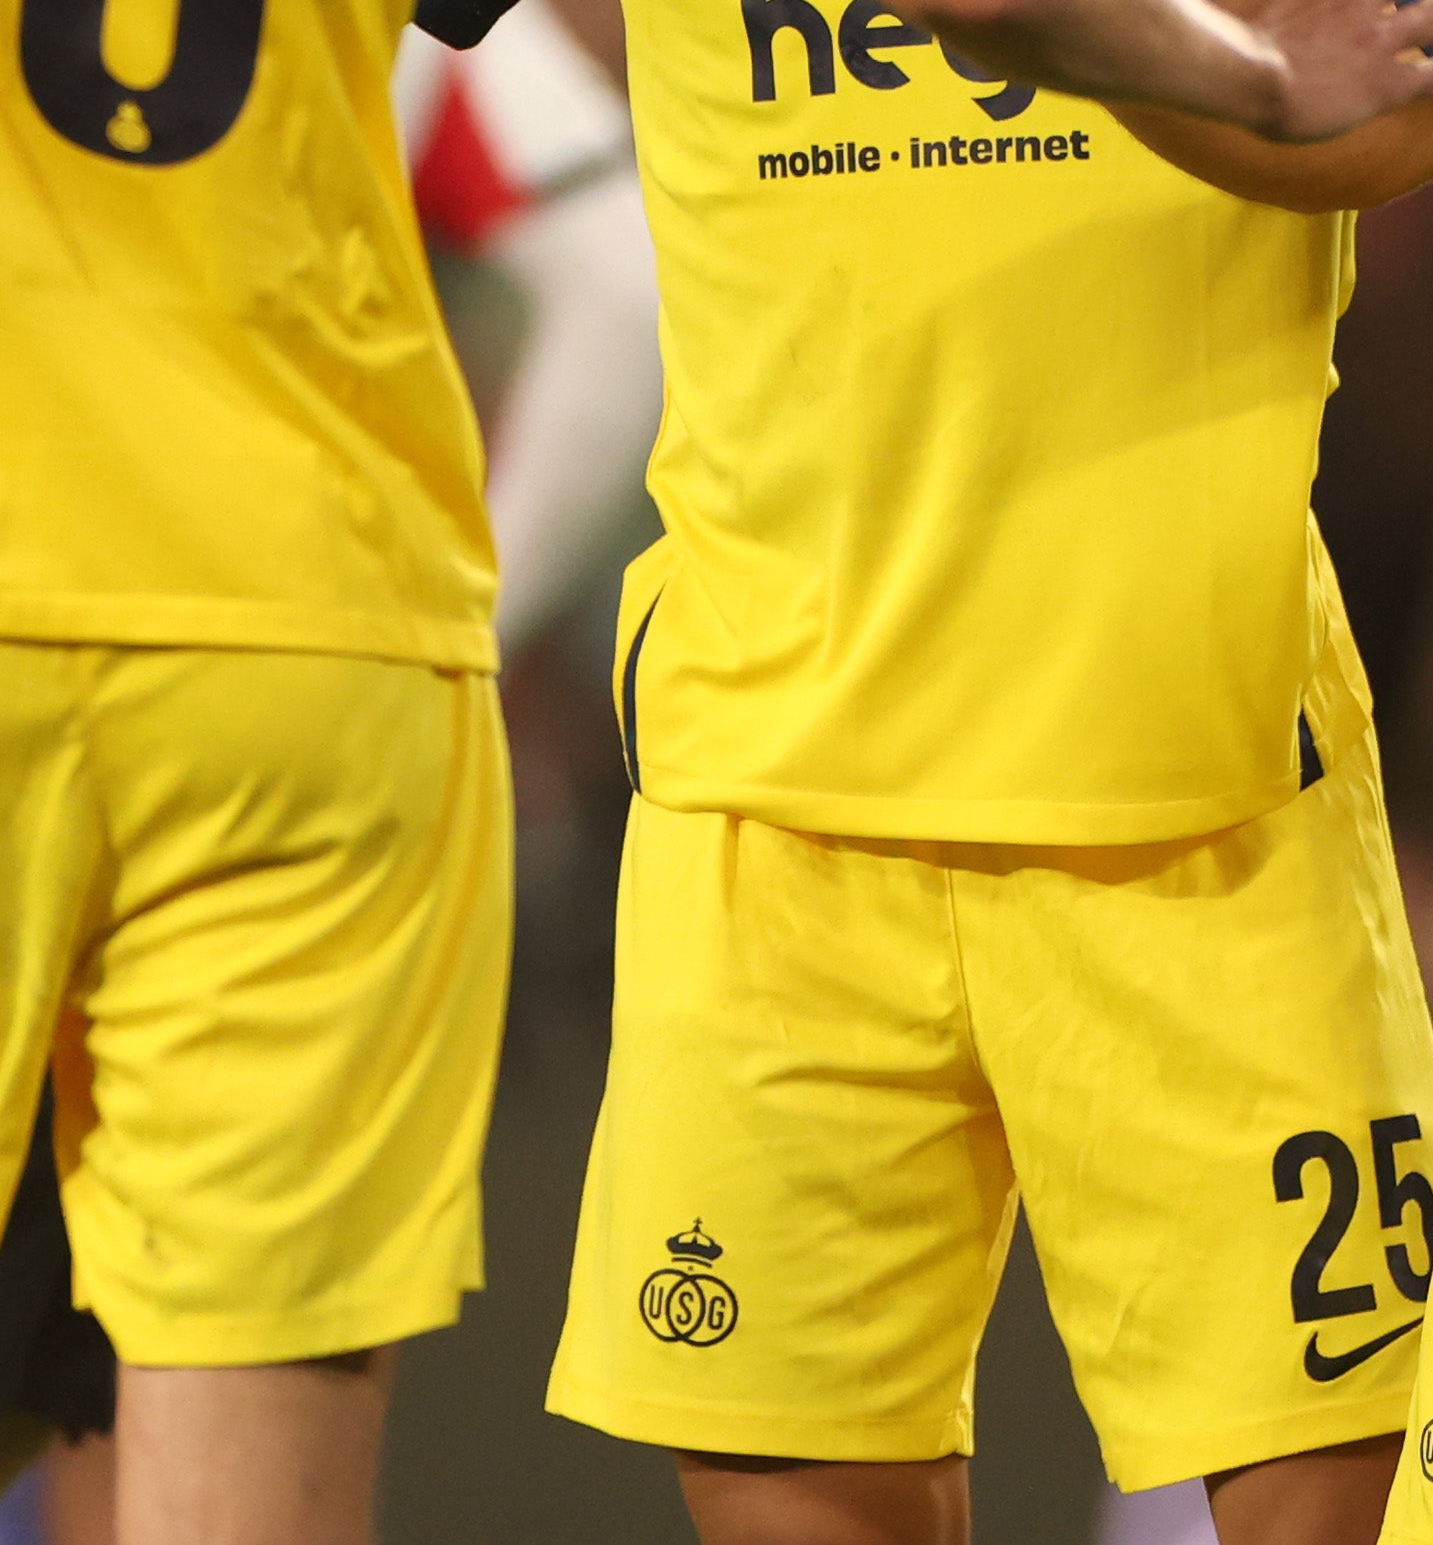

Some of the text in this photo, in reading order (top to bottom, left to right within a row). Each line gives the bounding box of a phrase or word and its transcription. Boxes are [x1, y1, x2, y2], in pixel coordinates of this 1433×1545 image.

[758, 129, 1090, 180] mobile internet
[649, 1285, 726, 1330] USG
